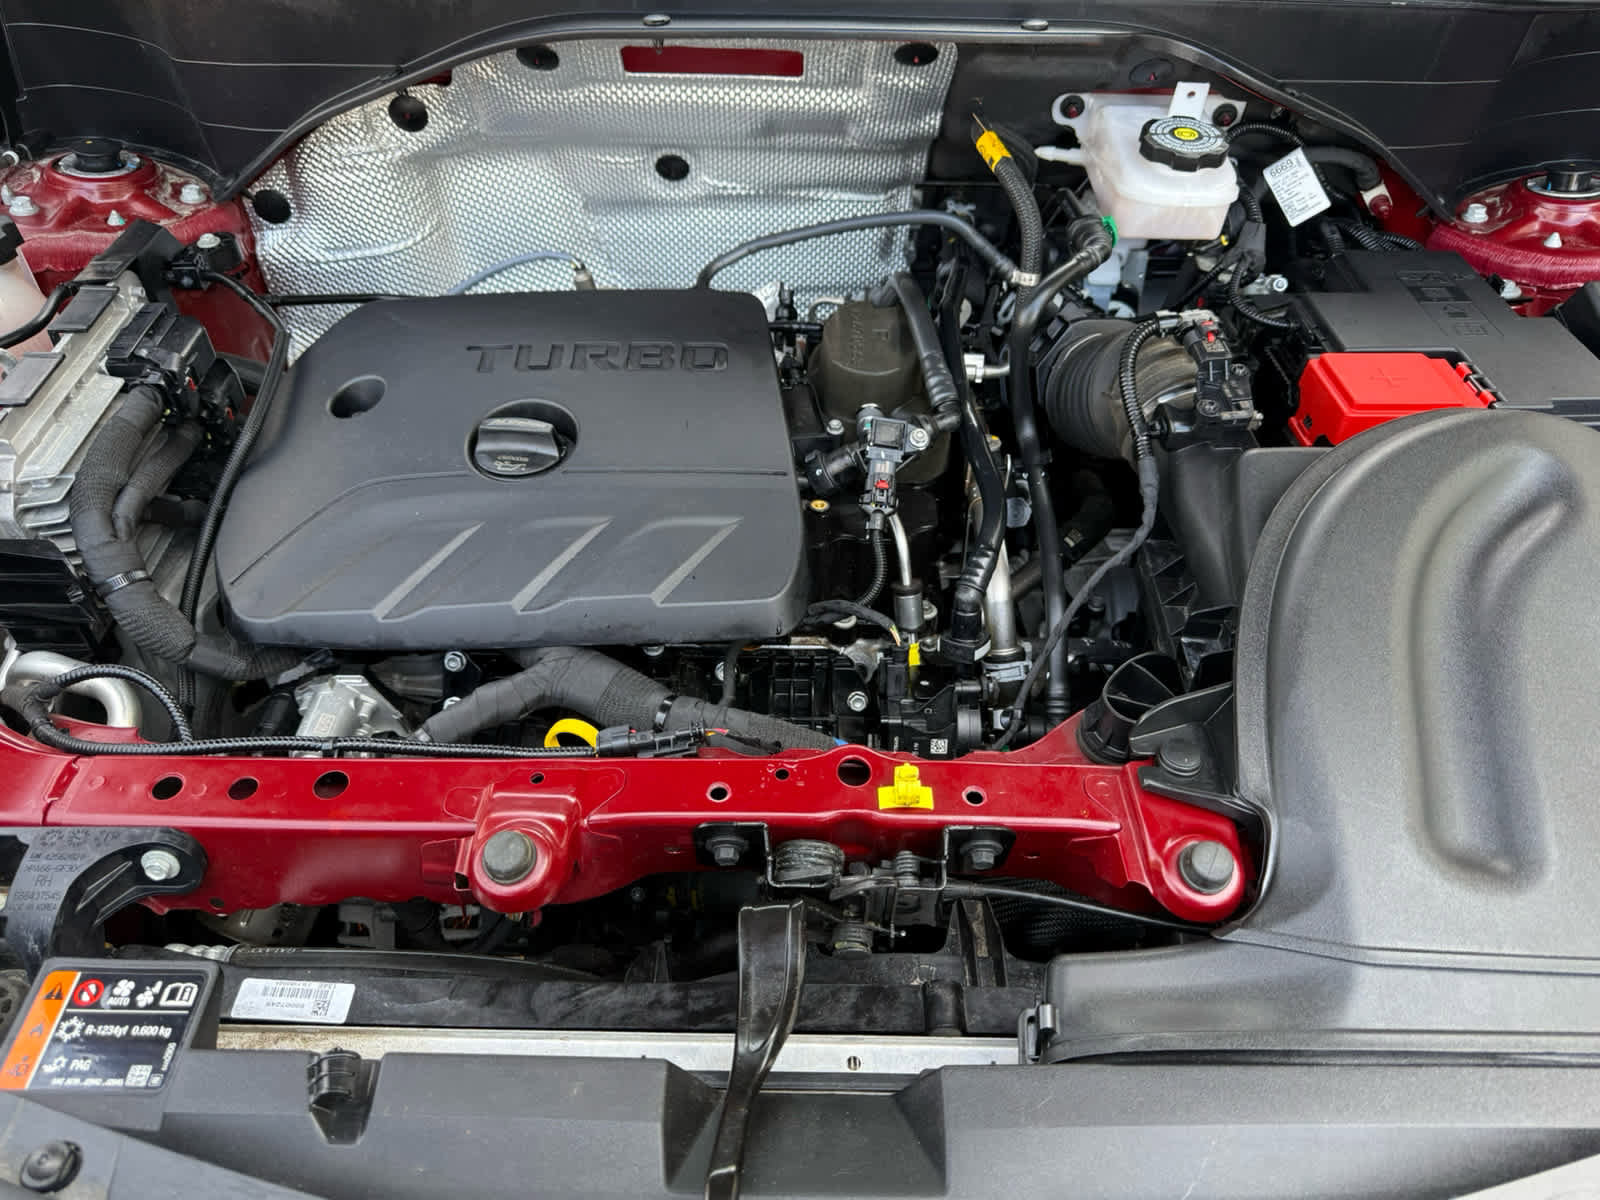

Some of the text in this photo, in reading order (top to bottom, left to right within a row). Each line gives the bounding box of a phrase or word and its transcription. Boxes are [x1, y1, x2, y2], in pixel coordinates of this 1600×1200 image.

[466, 342, 729, 373] TURBO
[106, 996, 130, 1006] AUTO
[84, 1024, 173, 1039] R-1234yf 0.600 kg
[69, 1059, 93, 1072] PAG
